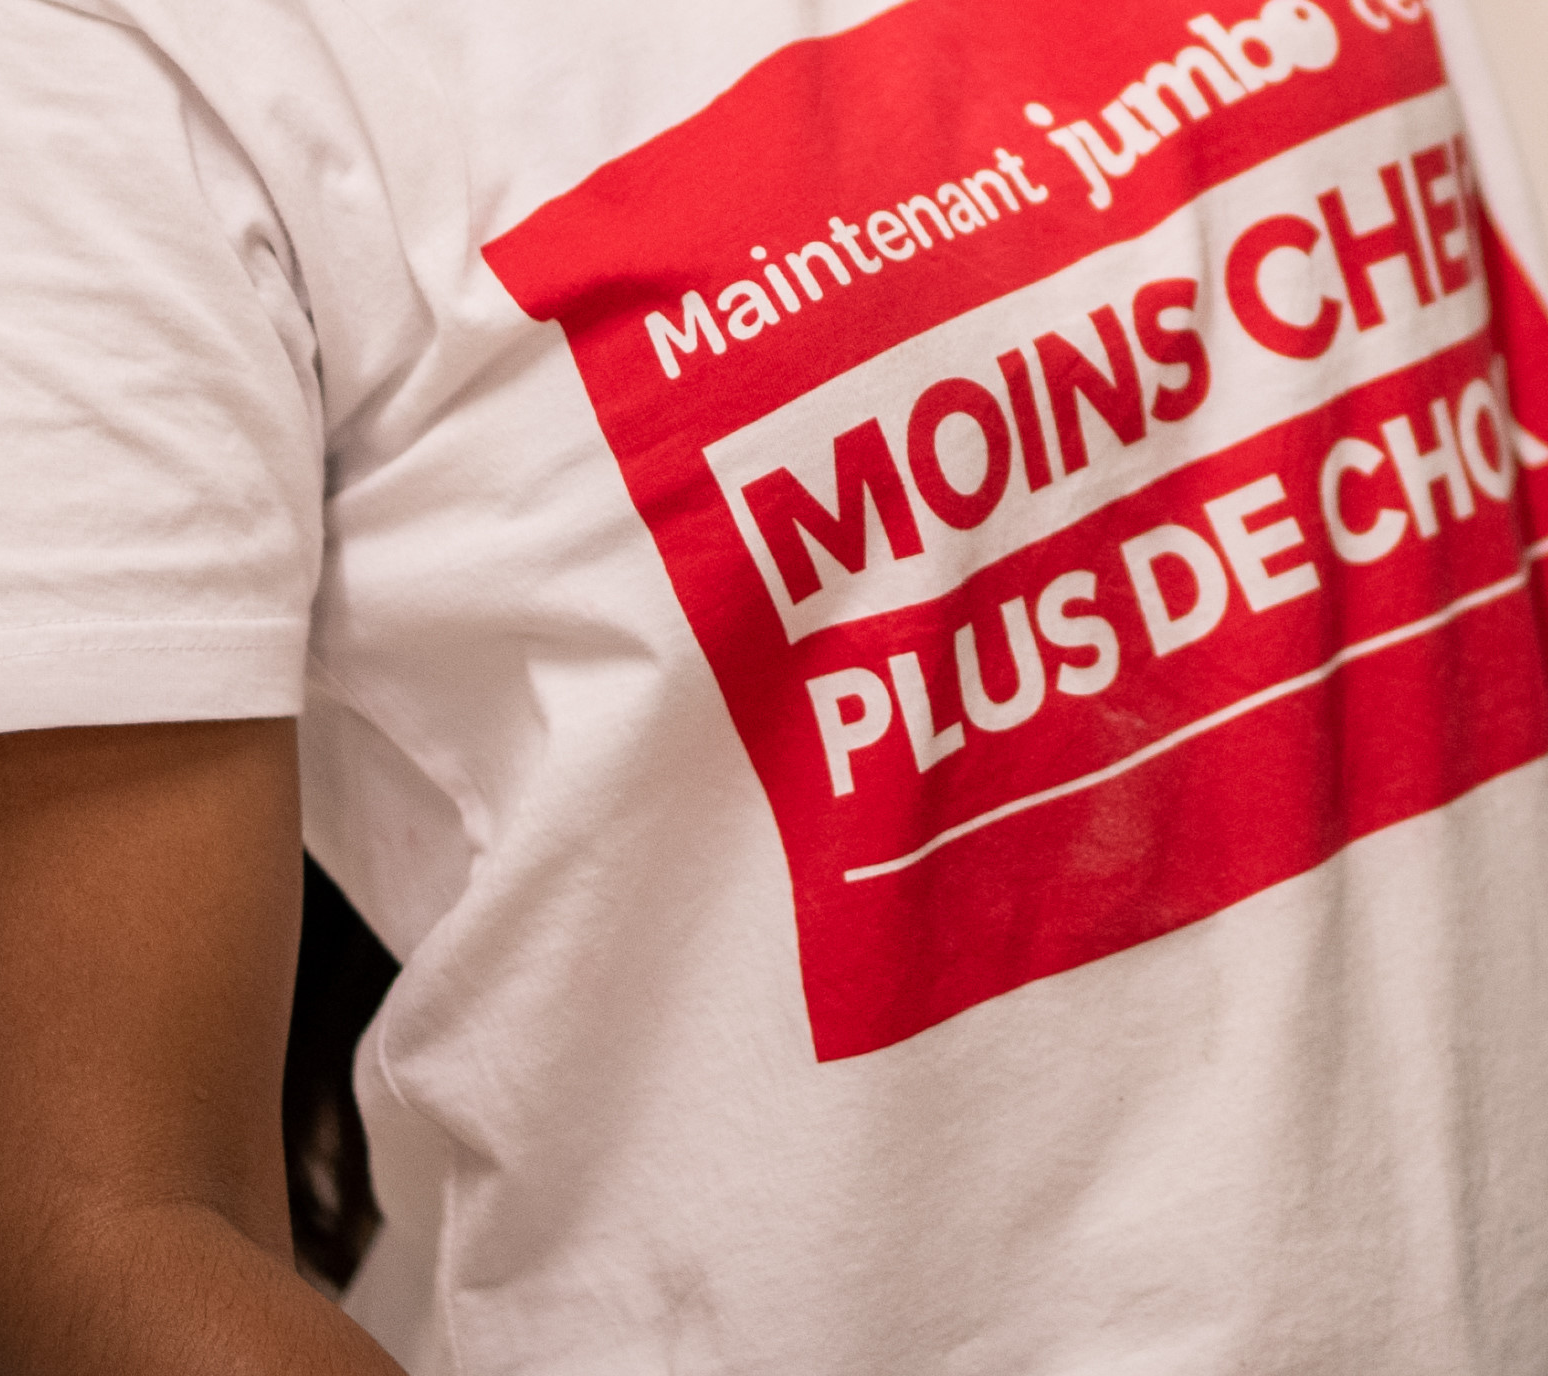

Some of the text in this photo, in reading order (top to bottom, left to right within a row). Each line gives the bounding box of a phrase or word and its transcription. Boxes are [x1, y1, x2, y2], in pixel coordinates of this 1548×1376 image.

[642, 145, 1050, 380] Maintenant
[739, 132, 1482, 608] MOINS CHE
[805, 566, 1120, 798] PLUS
[1119, 475, 1322, 660] DE
